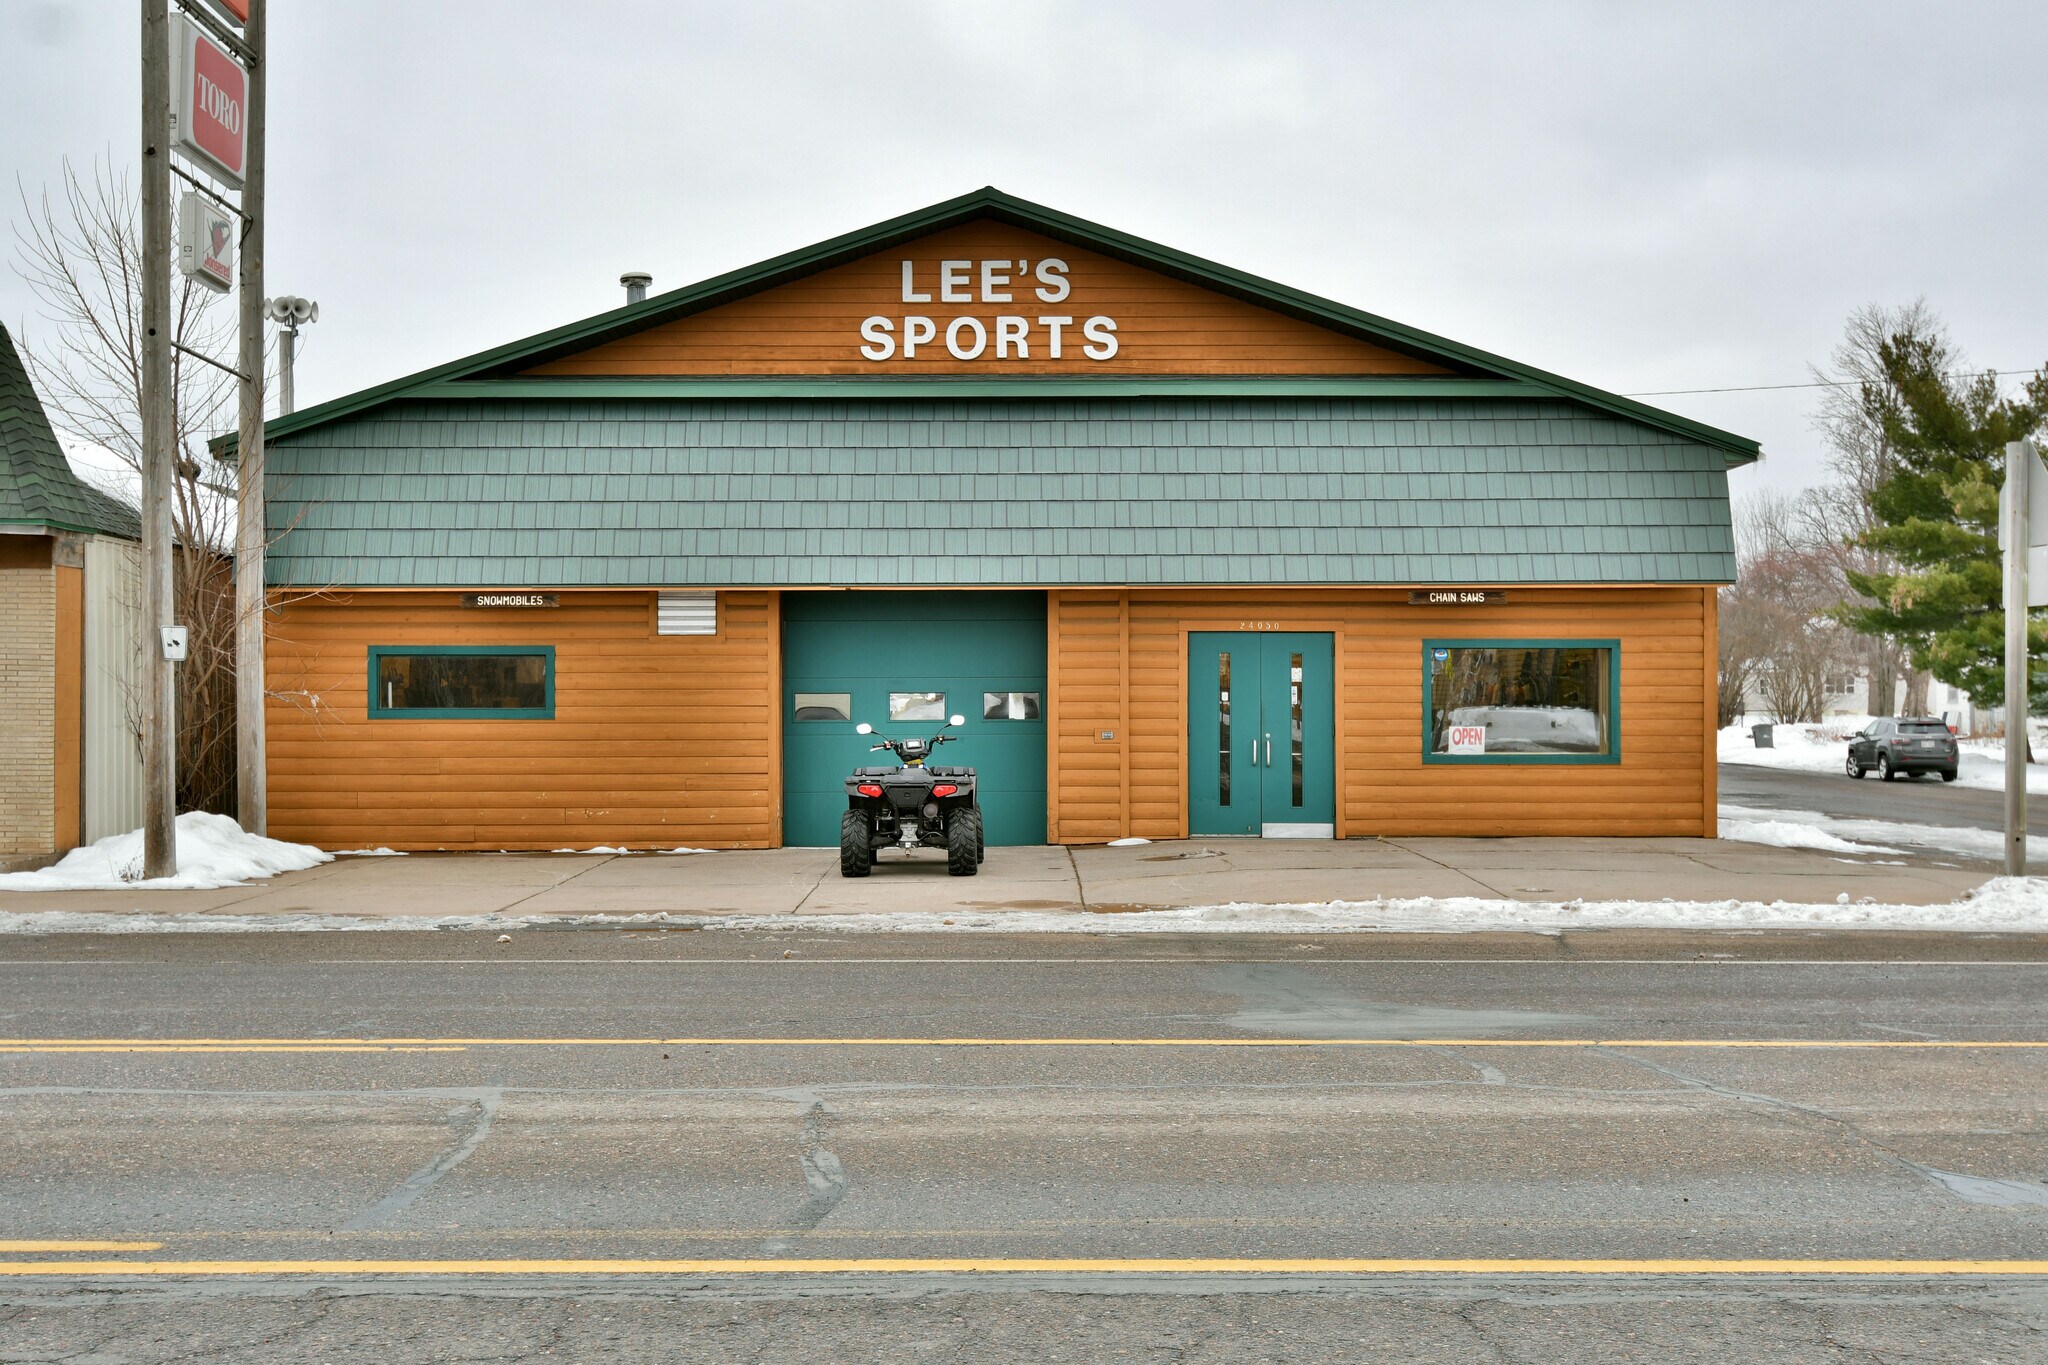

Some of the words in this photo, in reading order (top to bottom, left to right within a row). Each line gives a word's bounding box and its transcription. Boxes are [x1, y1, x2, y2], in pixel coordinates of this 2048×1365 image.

[198, 73, 241, 135] TORO
[902, 258, 1071, 303] LEE'S
[860, 315, 1119, 361] SPORTS
[477, 595, 543, 606] SNOWMOBILES
[1429, 592, 1457, 603] CHAIN
[1460, 592, 1485, 603] SAWS
[1240, 621, 1280, 630] 24050
[1452, 727, 1483, 746] OPEN
